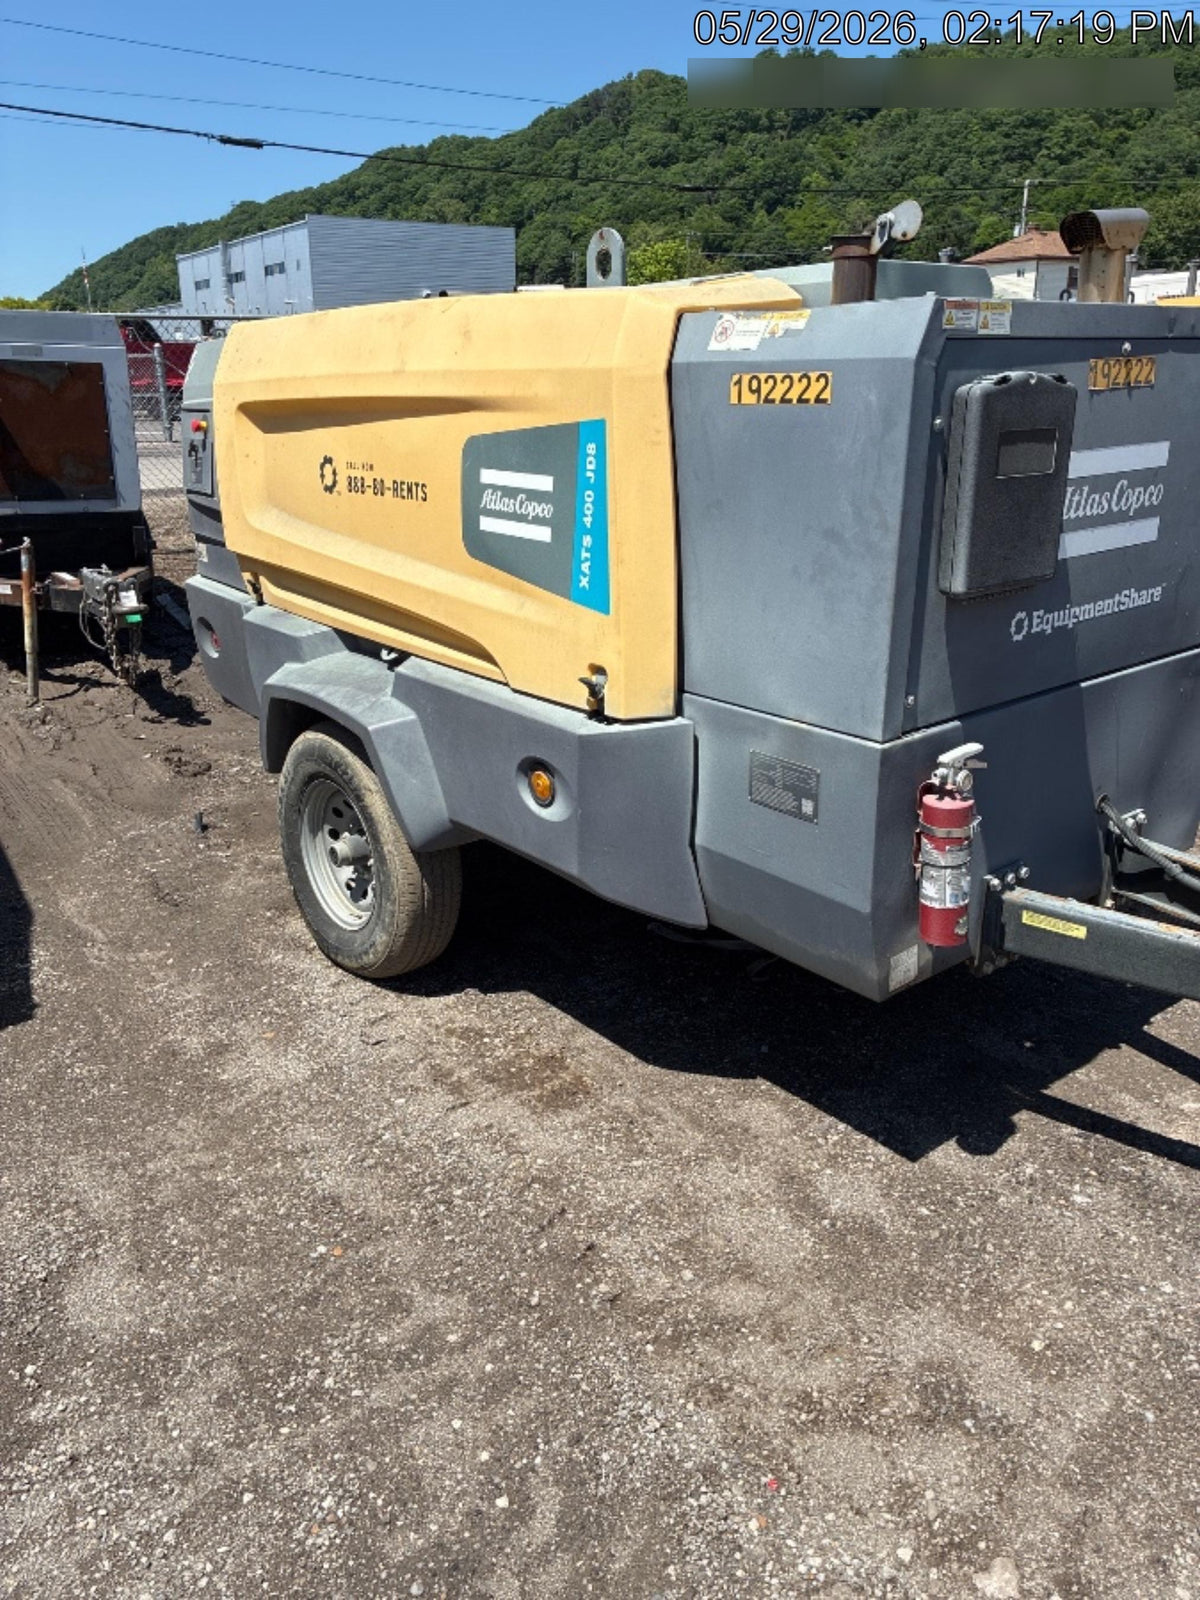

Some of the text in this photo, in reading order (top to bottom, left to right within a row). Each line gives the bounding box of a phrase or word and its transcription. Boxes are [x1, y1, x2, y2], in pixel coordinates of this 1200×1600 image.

[732, 373, 830, 404] 192222
[1089, 356, 1156, 389] 192222
[346, 475, 428, 502] 888-80-RENTS
[578, 442, 598, 591] XATS 400 JD8
[1030, 586, 1163, 635] EquipmentShare
